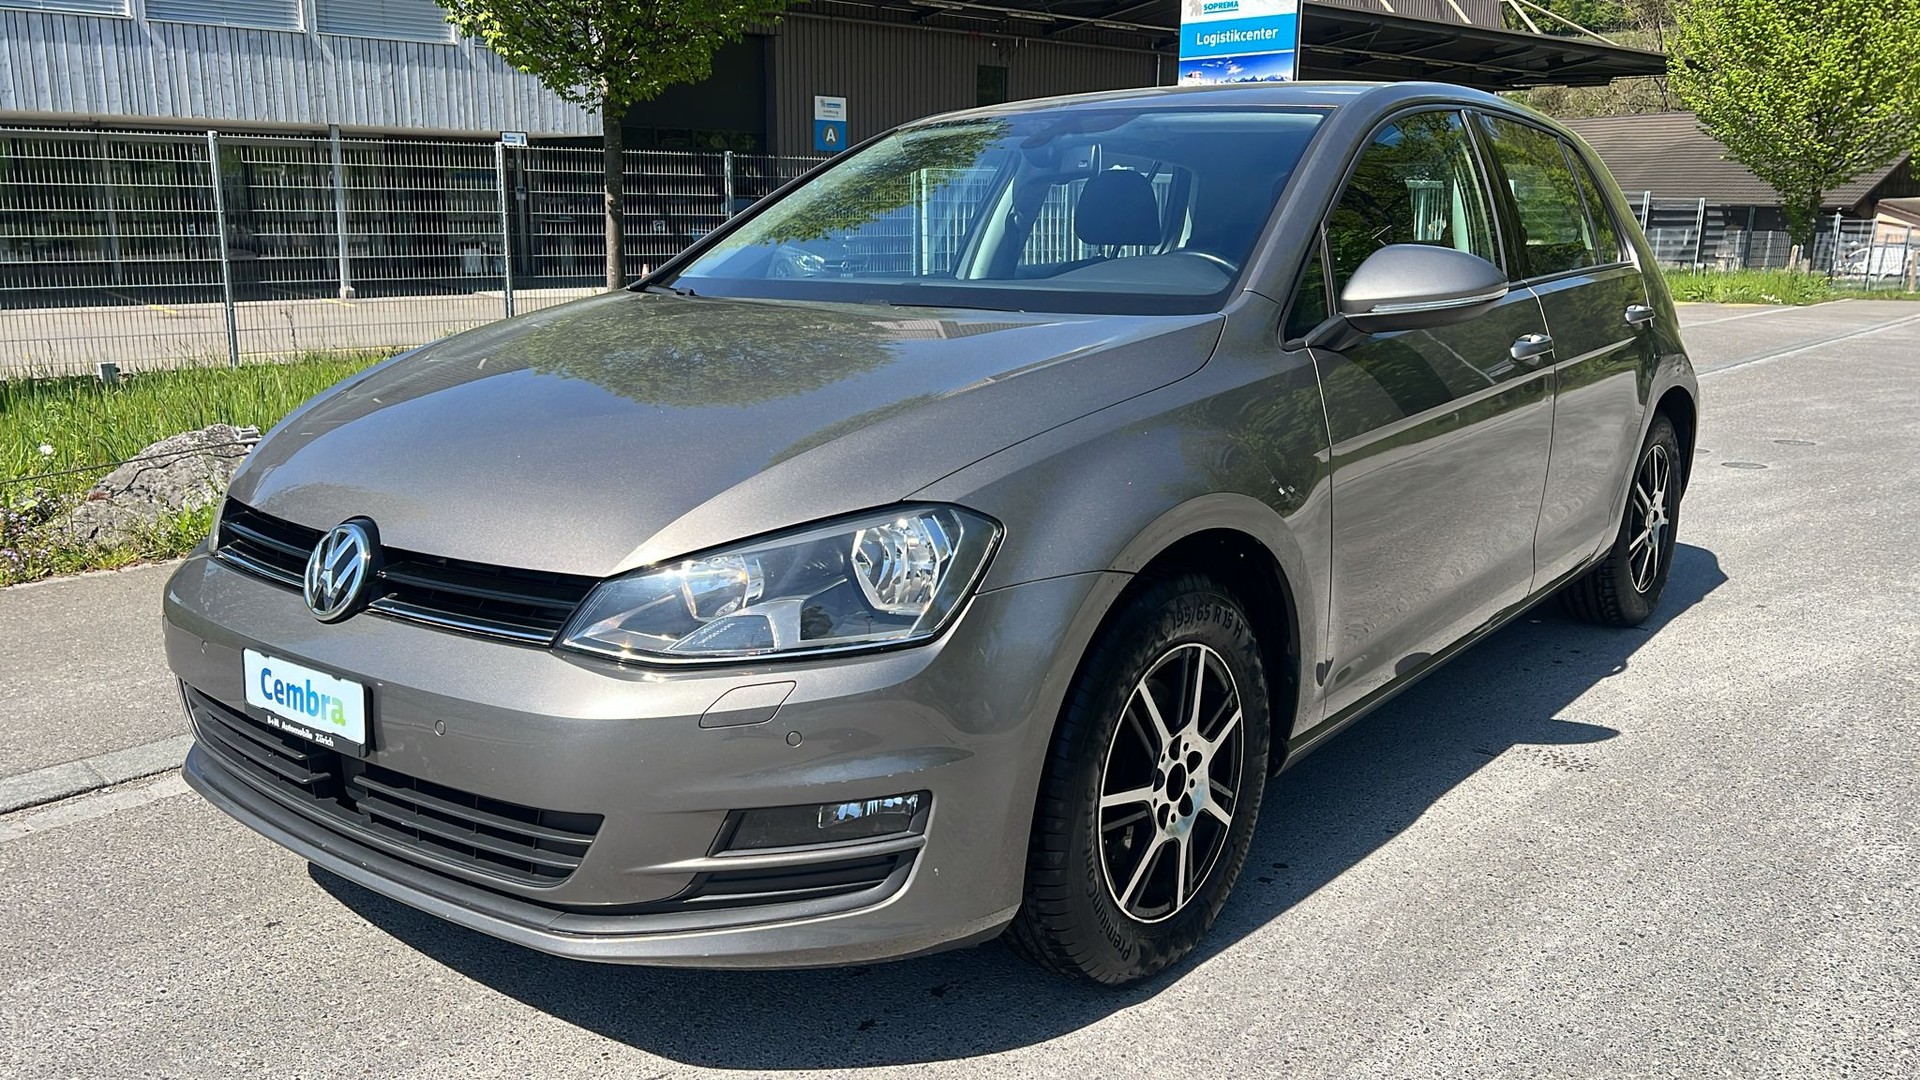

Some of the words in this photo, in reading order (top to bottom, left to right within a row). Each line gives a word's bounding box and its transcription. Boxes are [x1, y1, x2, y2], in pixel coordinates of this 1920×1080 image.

[1203, 1, 1239, 11] SOPREMA
[1196, 27, 1279, 47] Logistikcenter
[826, 128, 836, 142] A
[1213, 605, 1222, 625] R
[1233, 621, 1244, 640] H
[261, 667, 347, 727] Cembra
[281, 721, 313, 740] Automobile
